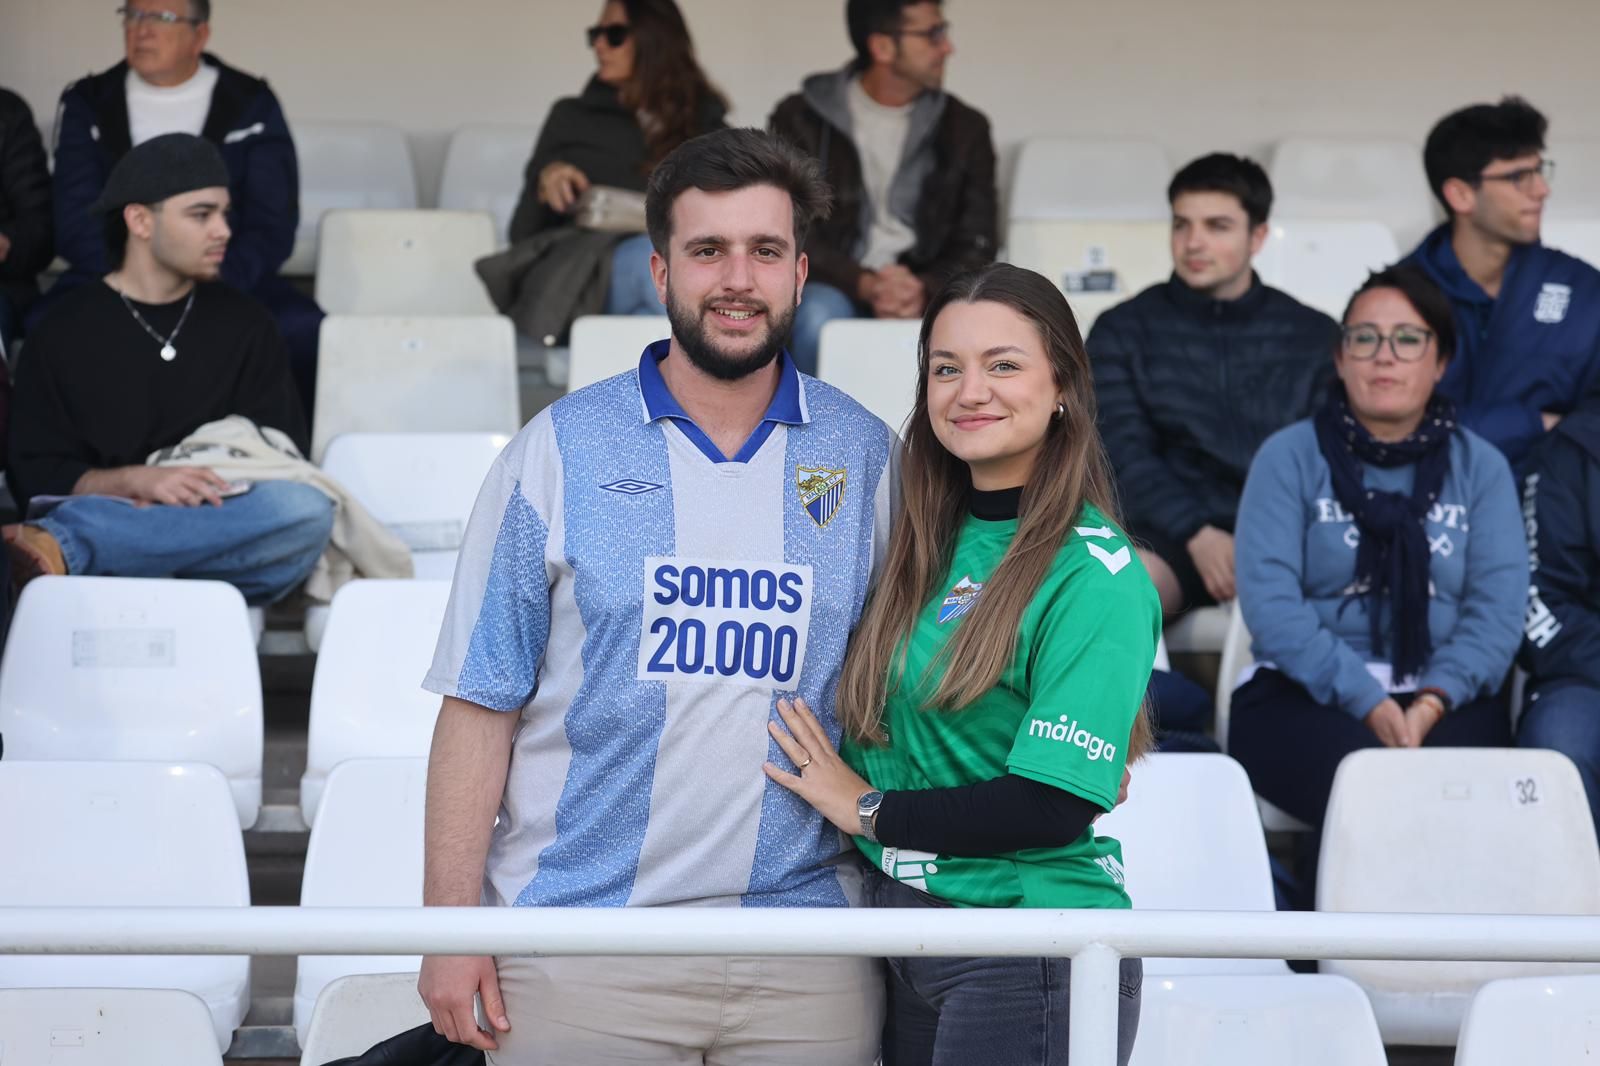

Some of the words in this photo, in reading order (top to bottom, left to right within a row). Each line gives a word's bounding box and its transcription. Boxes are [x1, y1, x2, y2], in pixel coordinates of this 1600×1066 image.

[653, 564, 804, 613] somos
[646, 616, 798, 683] 20.000
[1515, 778, 1539, 805] 32
